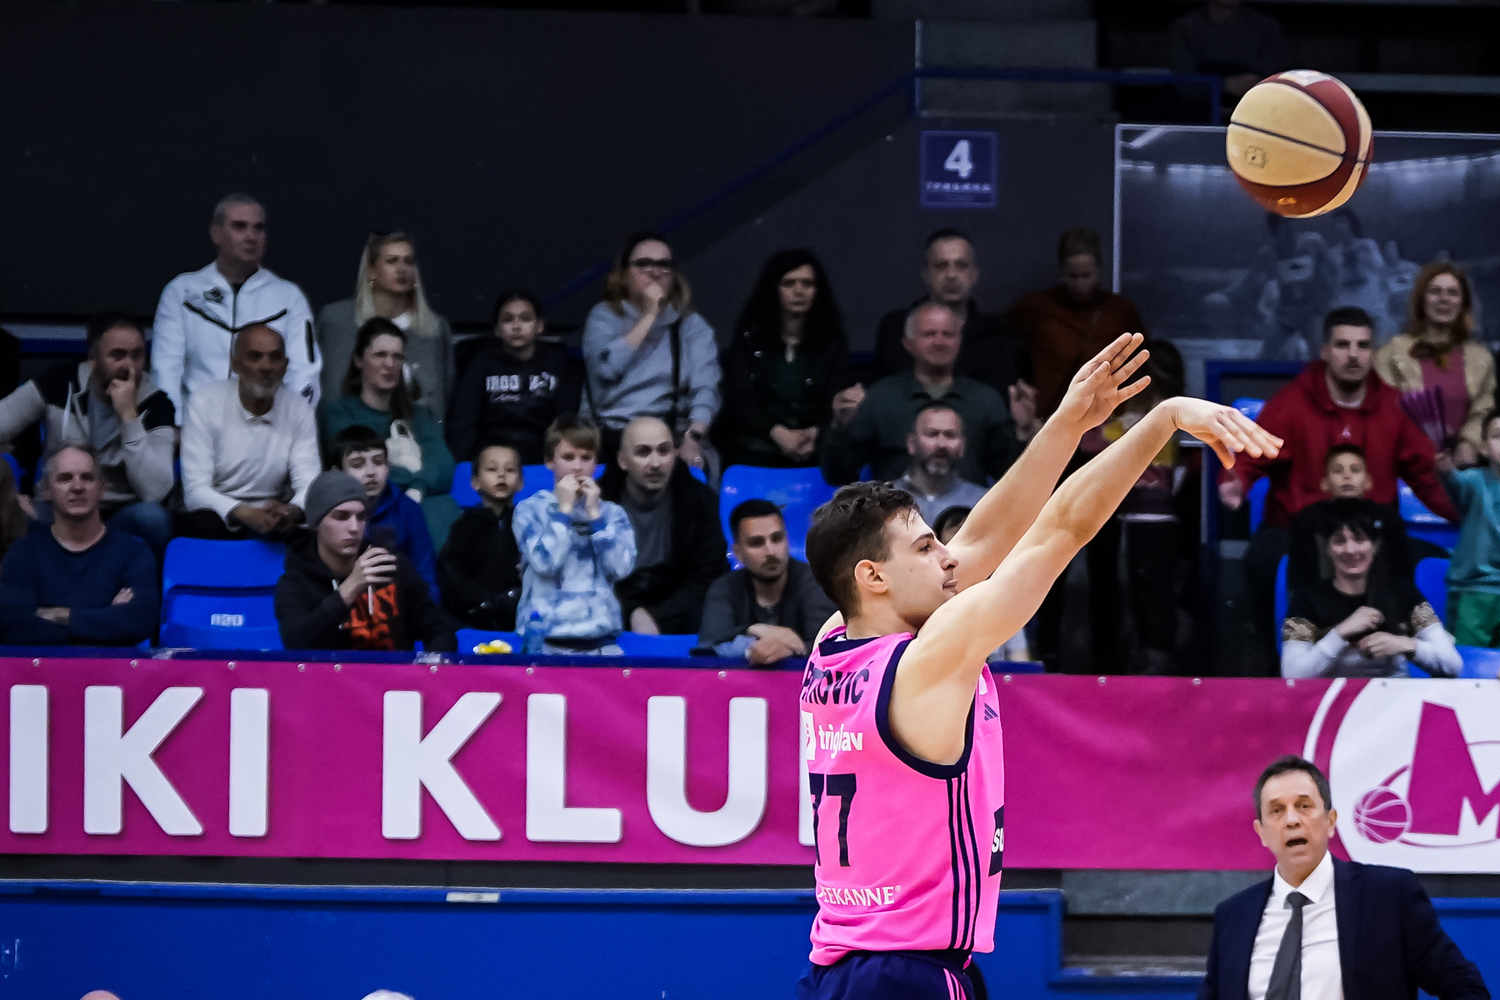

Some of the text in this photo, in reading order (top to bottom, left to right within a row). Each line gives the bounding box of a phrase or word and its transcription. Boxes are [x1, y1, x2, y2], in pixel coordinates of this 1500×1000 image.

[944, 139, 974, 179] 4
[818, 723, 863, 760] triglav
[9, 684, 815, 847] IKI KLU
